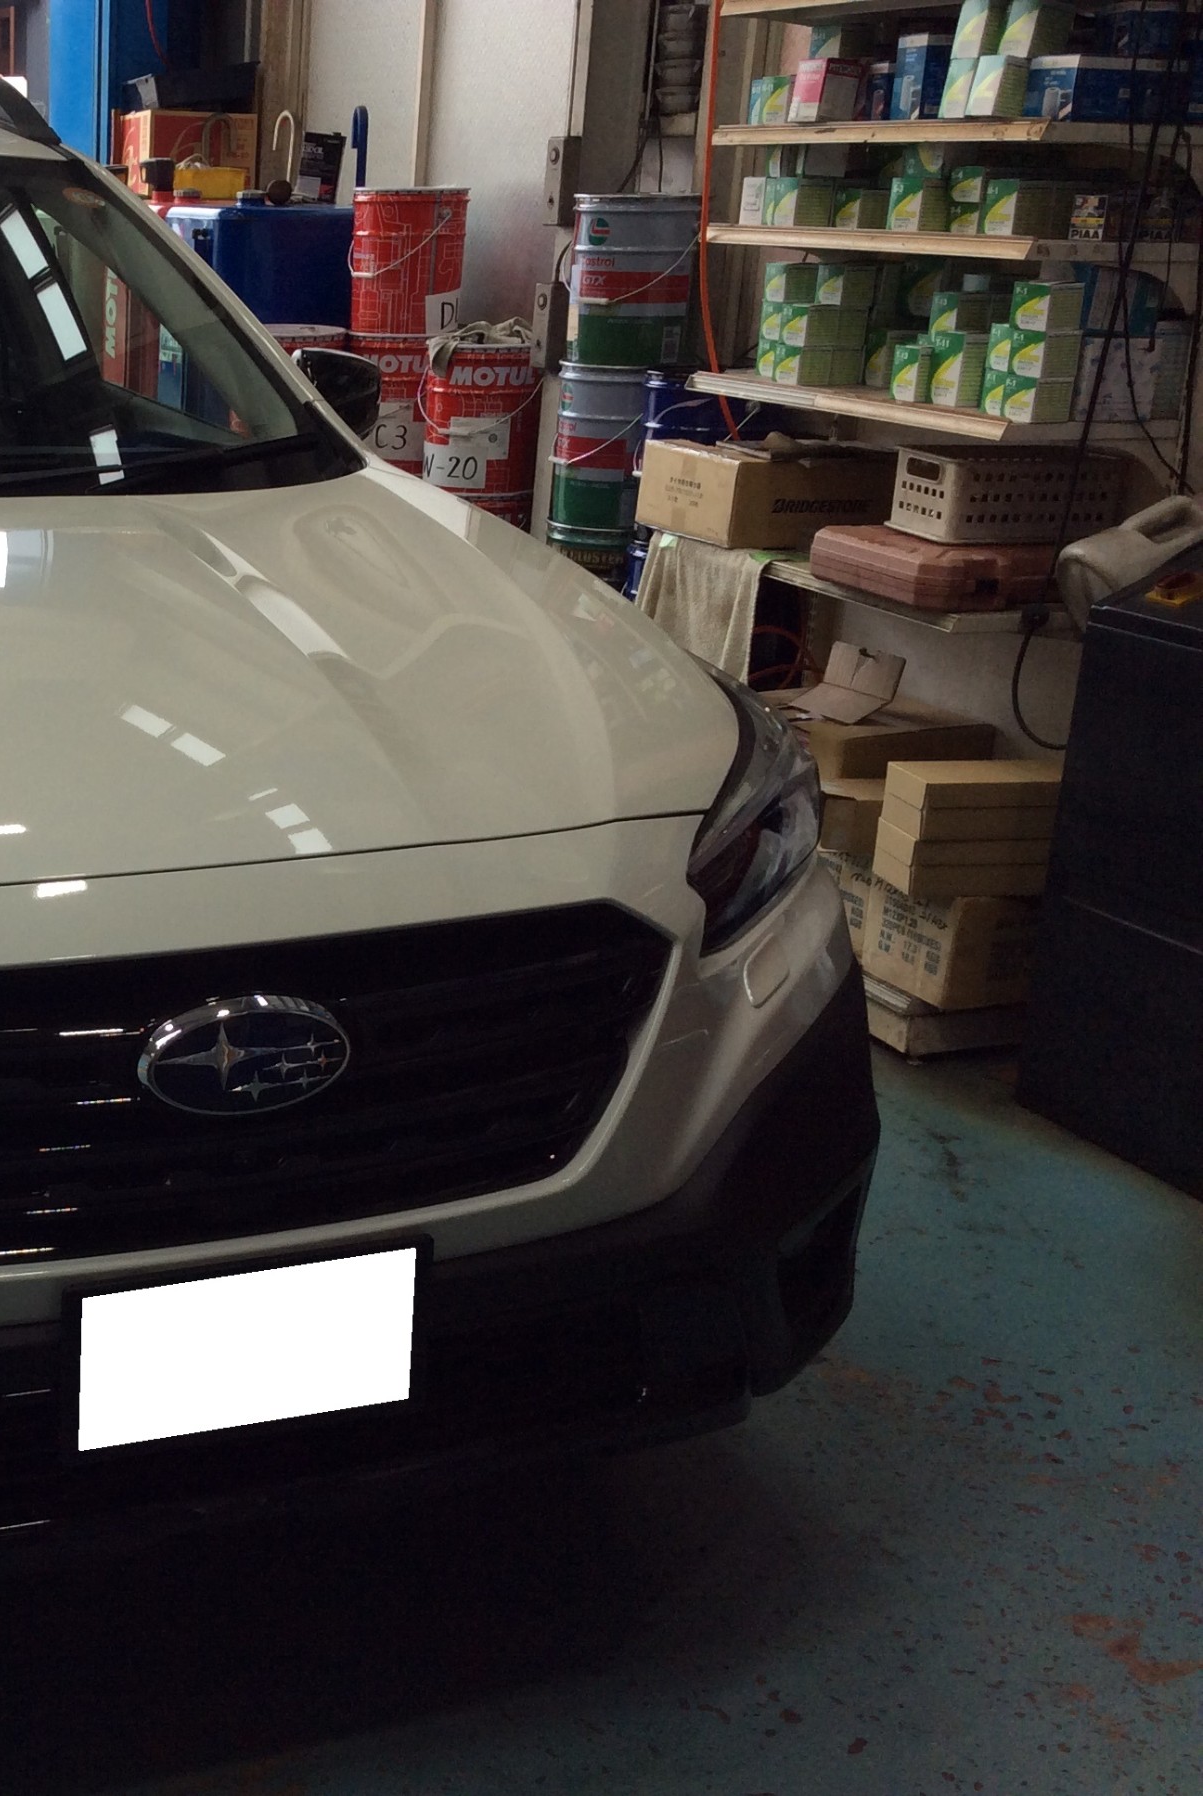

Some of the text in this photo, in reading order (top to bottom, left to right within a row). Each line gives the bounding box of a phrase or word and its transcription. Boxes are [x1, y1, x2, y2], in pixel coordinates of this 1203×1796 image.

[1071, 229, 1100, 239] PIAA
[449, 366, 536, 387] MOTUL
[771, 497, 874, 514] BRIDGESTONE
